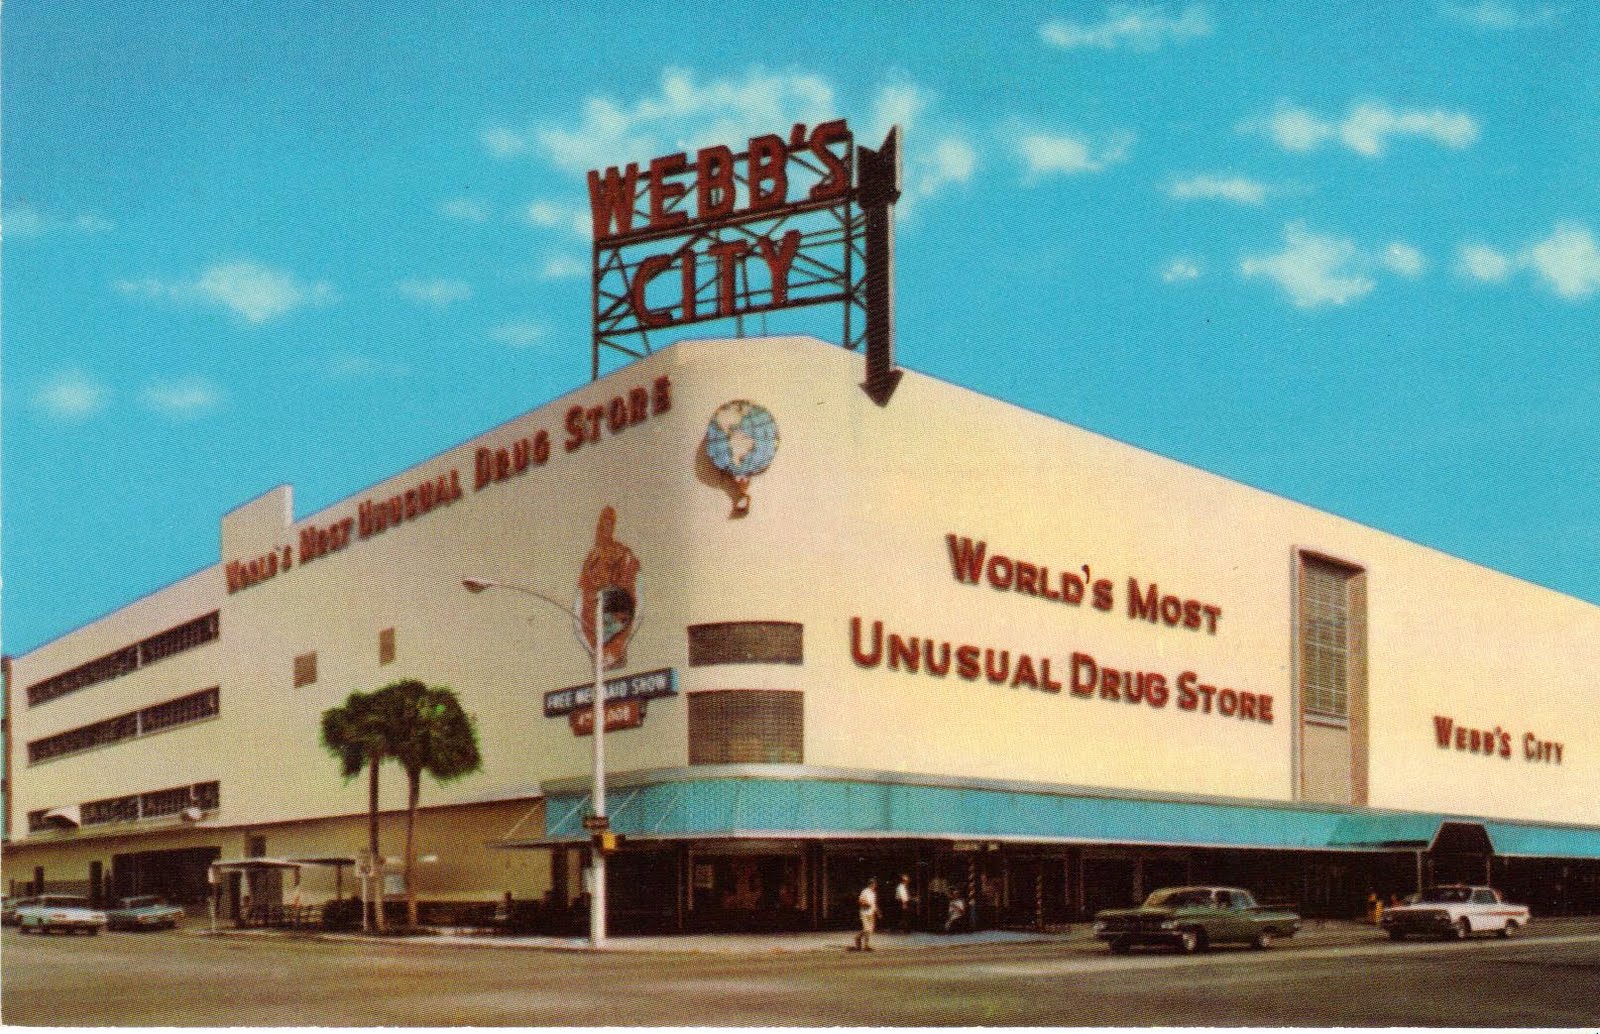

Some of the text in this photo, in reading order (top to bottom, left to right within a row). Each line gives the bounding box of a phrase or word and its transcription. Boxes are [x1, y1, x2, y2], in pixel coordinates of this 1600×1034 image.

[587, 119, 852, 241] WEBB'S
[631, 230, 801, 327] CITY
[225, 374, 671, 594] WORLD'S MOST UNUSUAL DRUG STORE
[945, 533, 1222, 635] WORLD'S MOST
[849, 615, 1275, 724] UNUSUAL DRUG STORE
[1433, 715, 1564, 765] WEBB'S CITY
